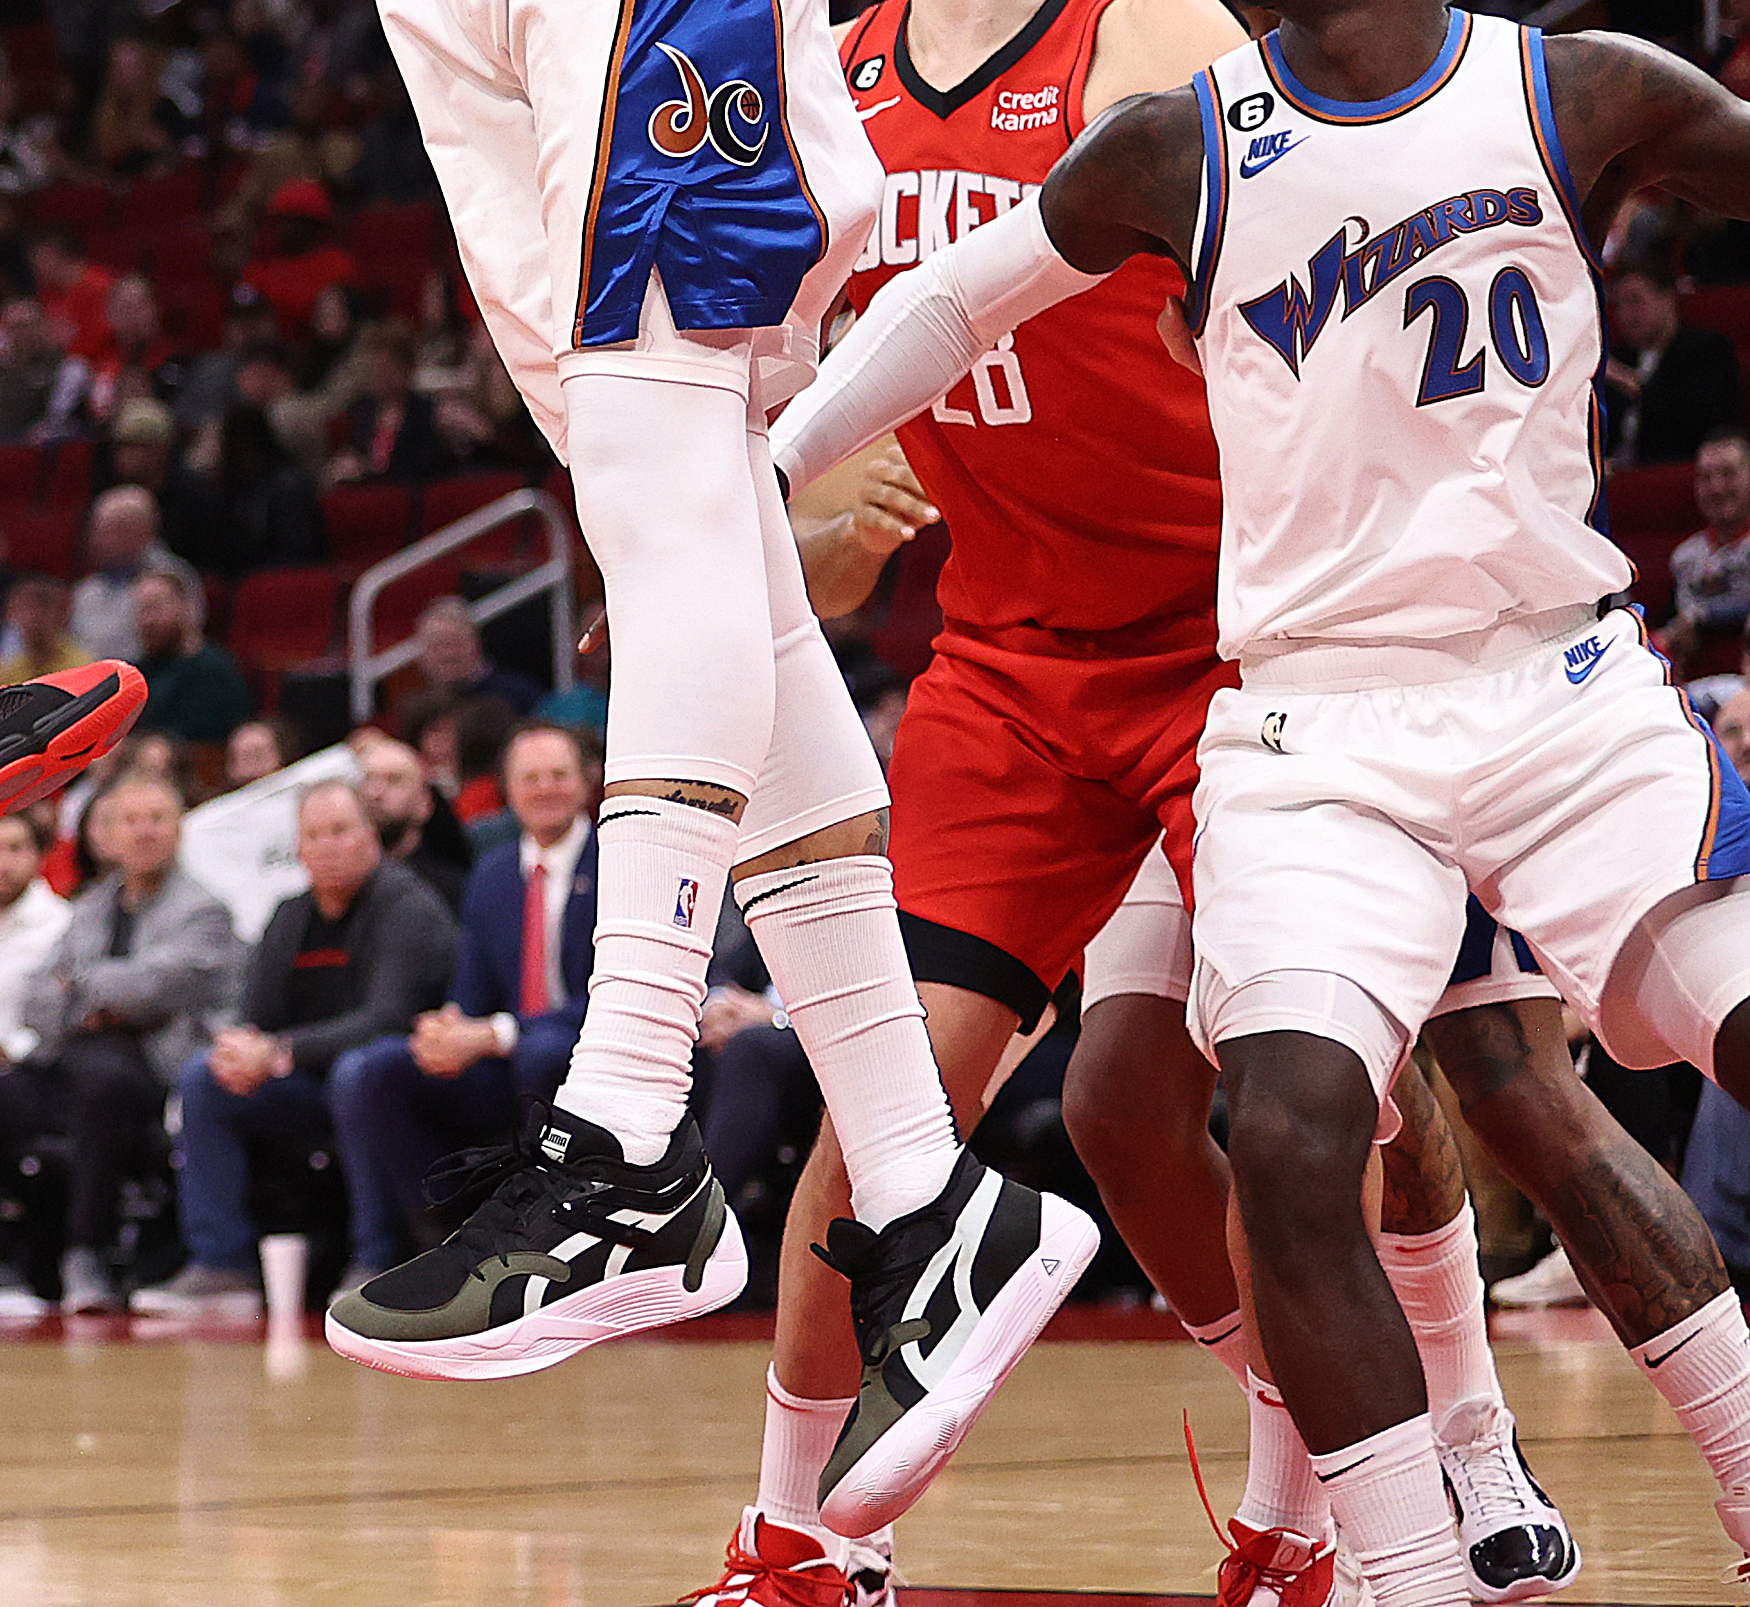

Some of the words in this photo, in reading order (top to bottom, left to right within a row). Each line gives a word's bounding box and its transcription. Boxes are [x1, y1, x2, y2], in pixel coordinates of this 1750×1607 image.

[855, 56, 884, 89] 6
[998, 85, 1060, 110] credit
[1239, 95, 1266, 129] 6
[990, 105, 1058, 131] karma
[1246, 129, 1293, 162] NIKE
[852, 169, 1044, 272] CKET
[1402, 265, 1551, 408] 20
[1562, 634, 1602, 669] NIKE
